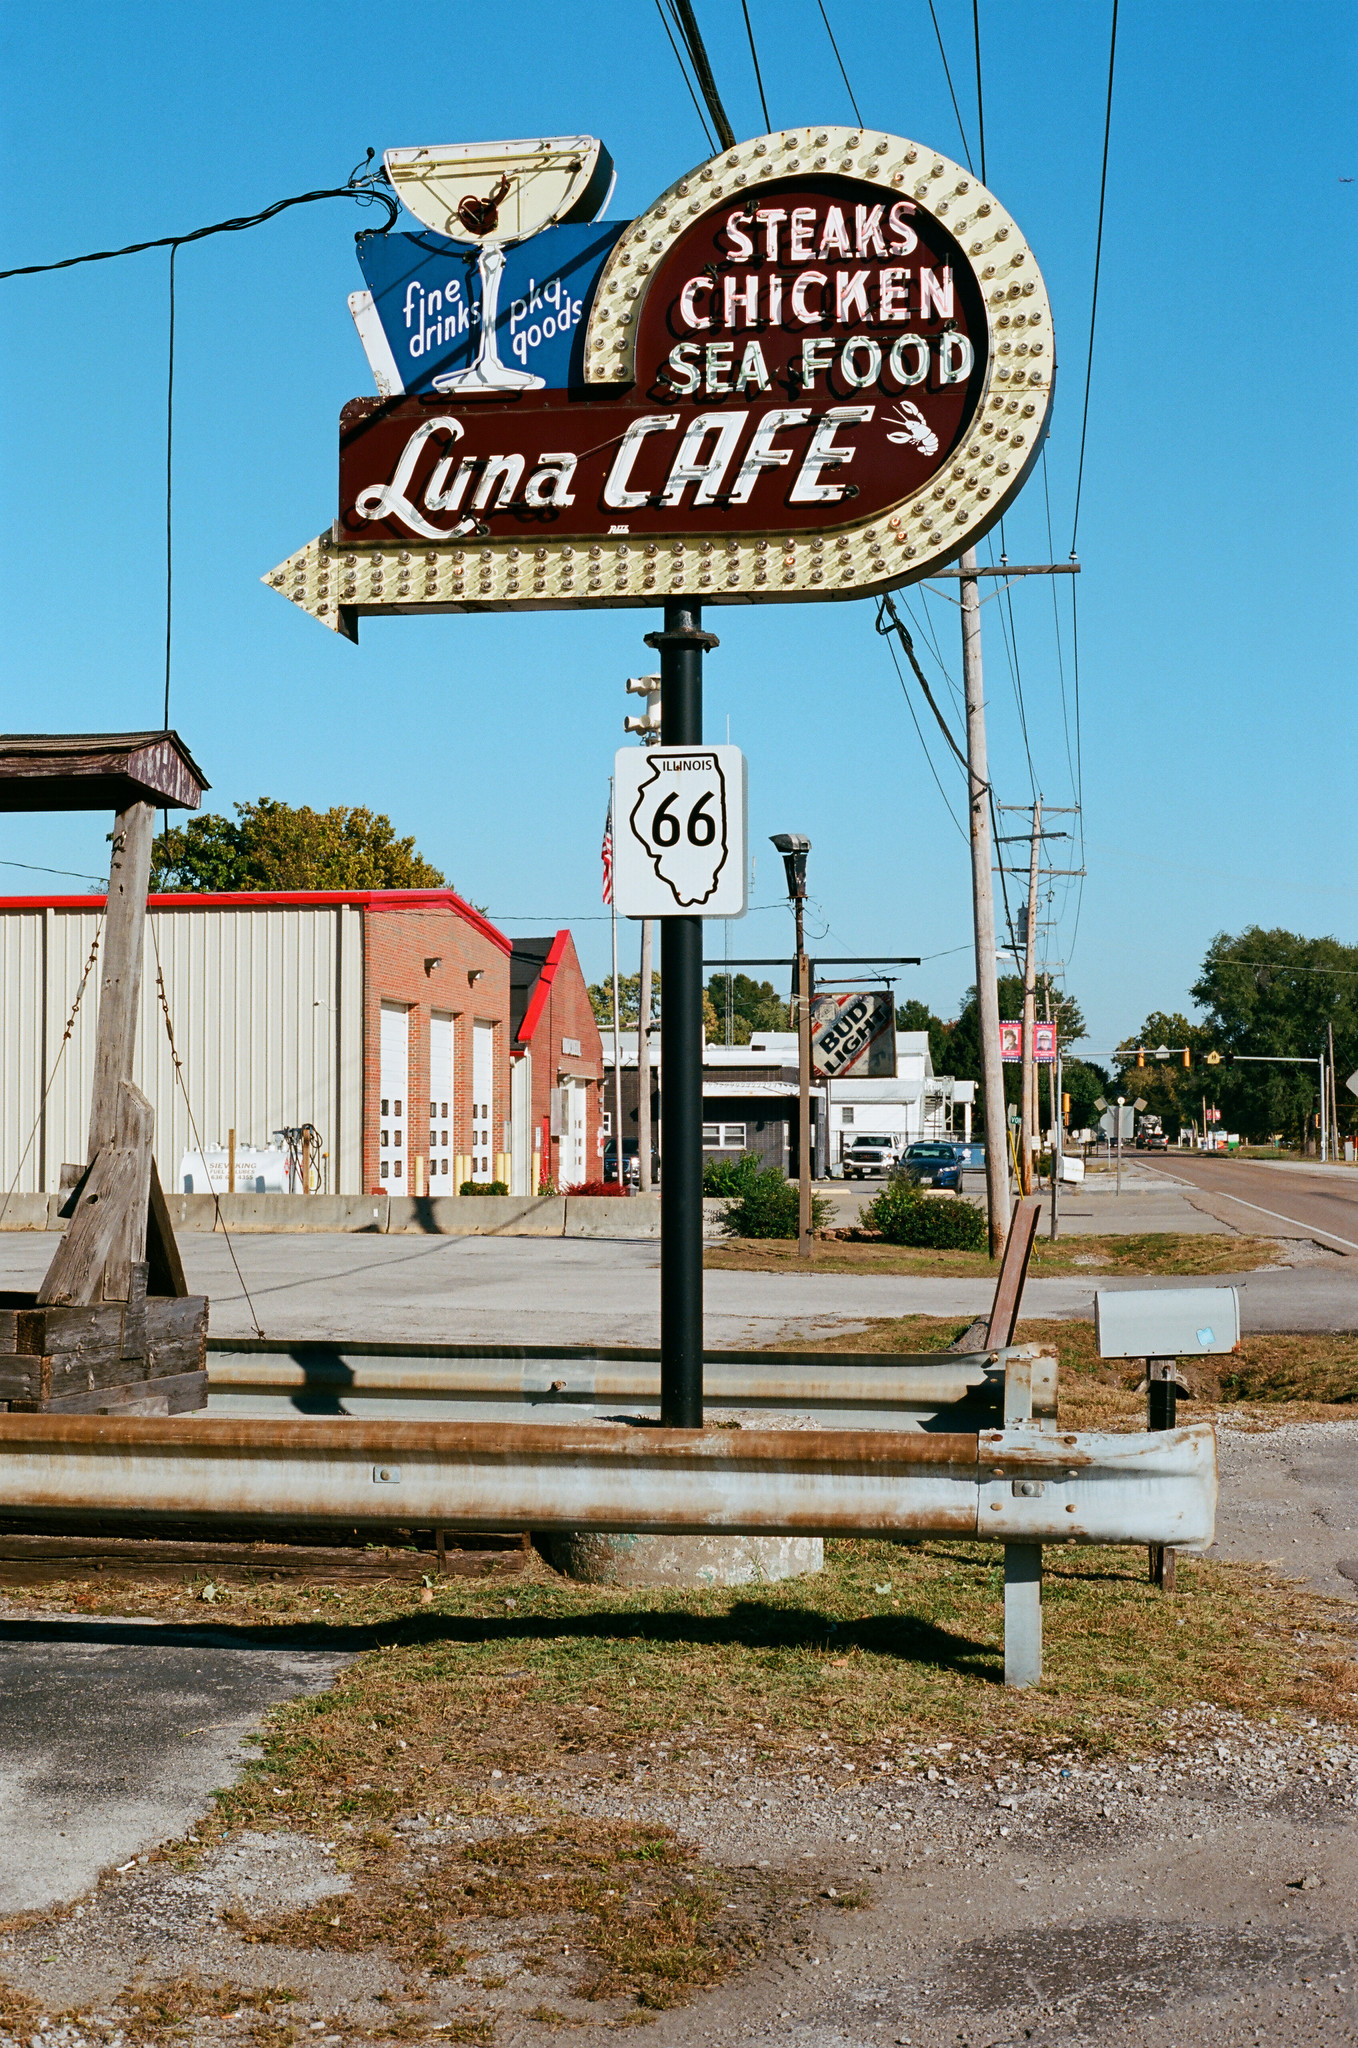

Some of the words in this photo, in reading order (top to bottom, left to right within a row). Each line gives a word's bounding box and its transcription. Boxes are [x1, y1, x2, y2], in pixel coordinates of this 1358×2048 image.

[726, 201, 919, 263] STEAKS
[403, 280, 461, 328] fine
[409, 298, 481, 357] drinks
[680, 266, 954, 330] CHICKEN
[668, 340, 772, 394] SEA
[802, 332, 974, 389] FOOD
[355, 416, 578, 539] Luna
[604, 405, 876, 508] CAFE
[662, 760, 712, 771] ILLINOIS
[652, 791, 716, 847] 66
[819, 1002, 868, 1055] BUD
[824, 1005, 886, 1075] LIGHT
